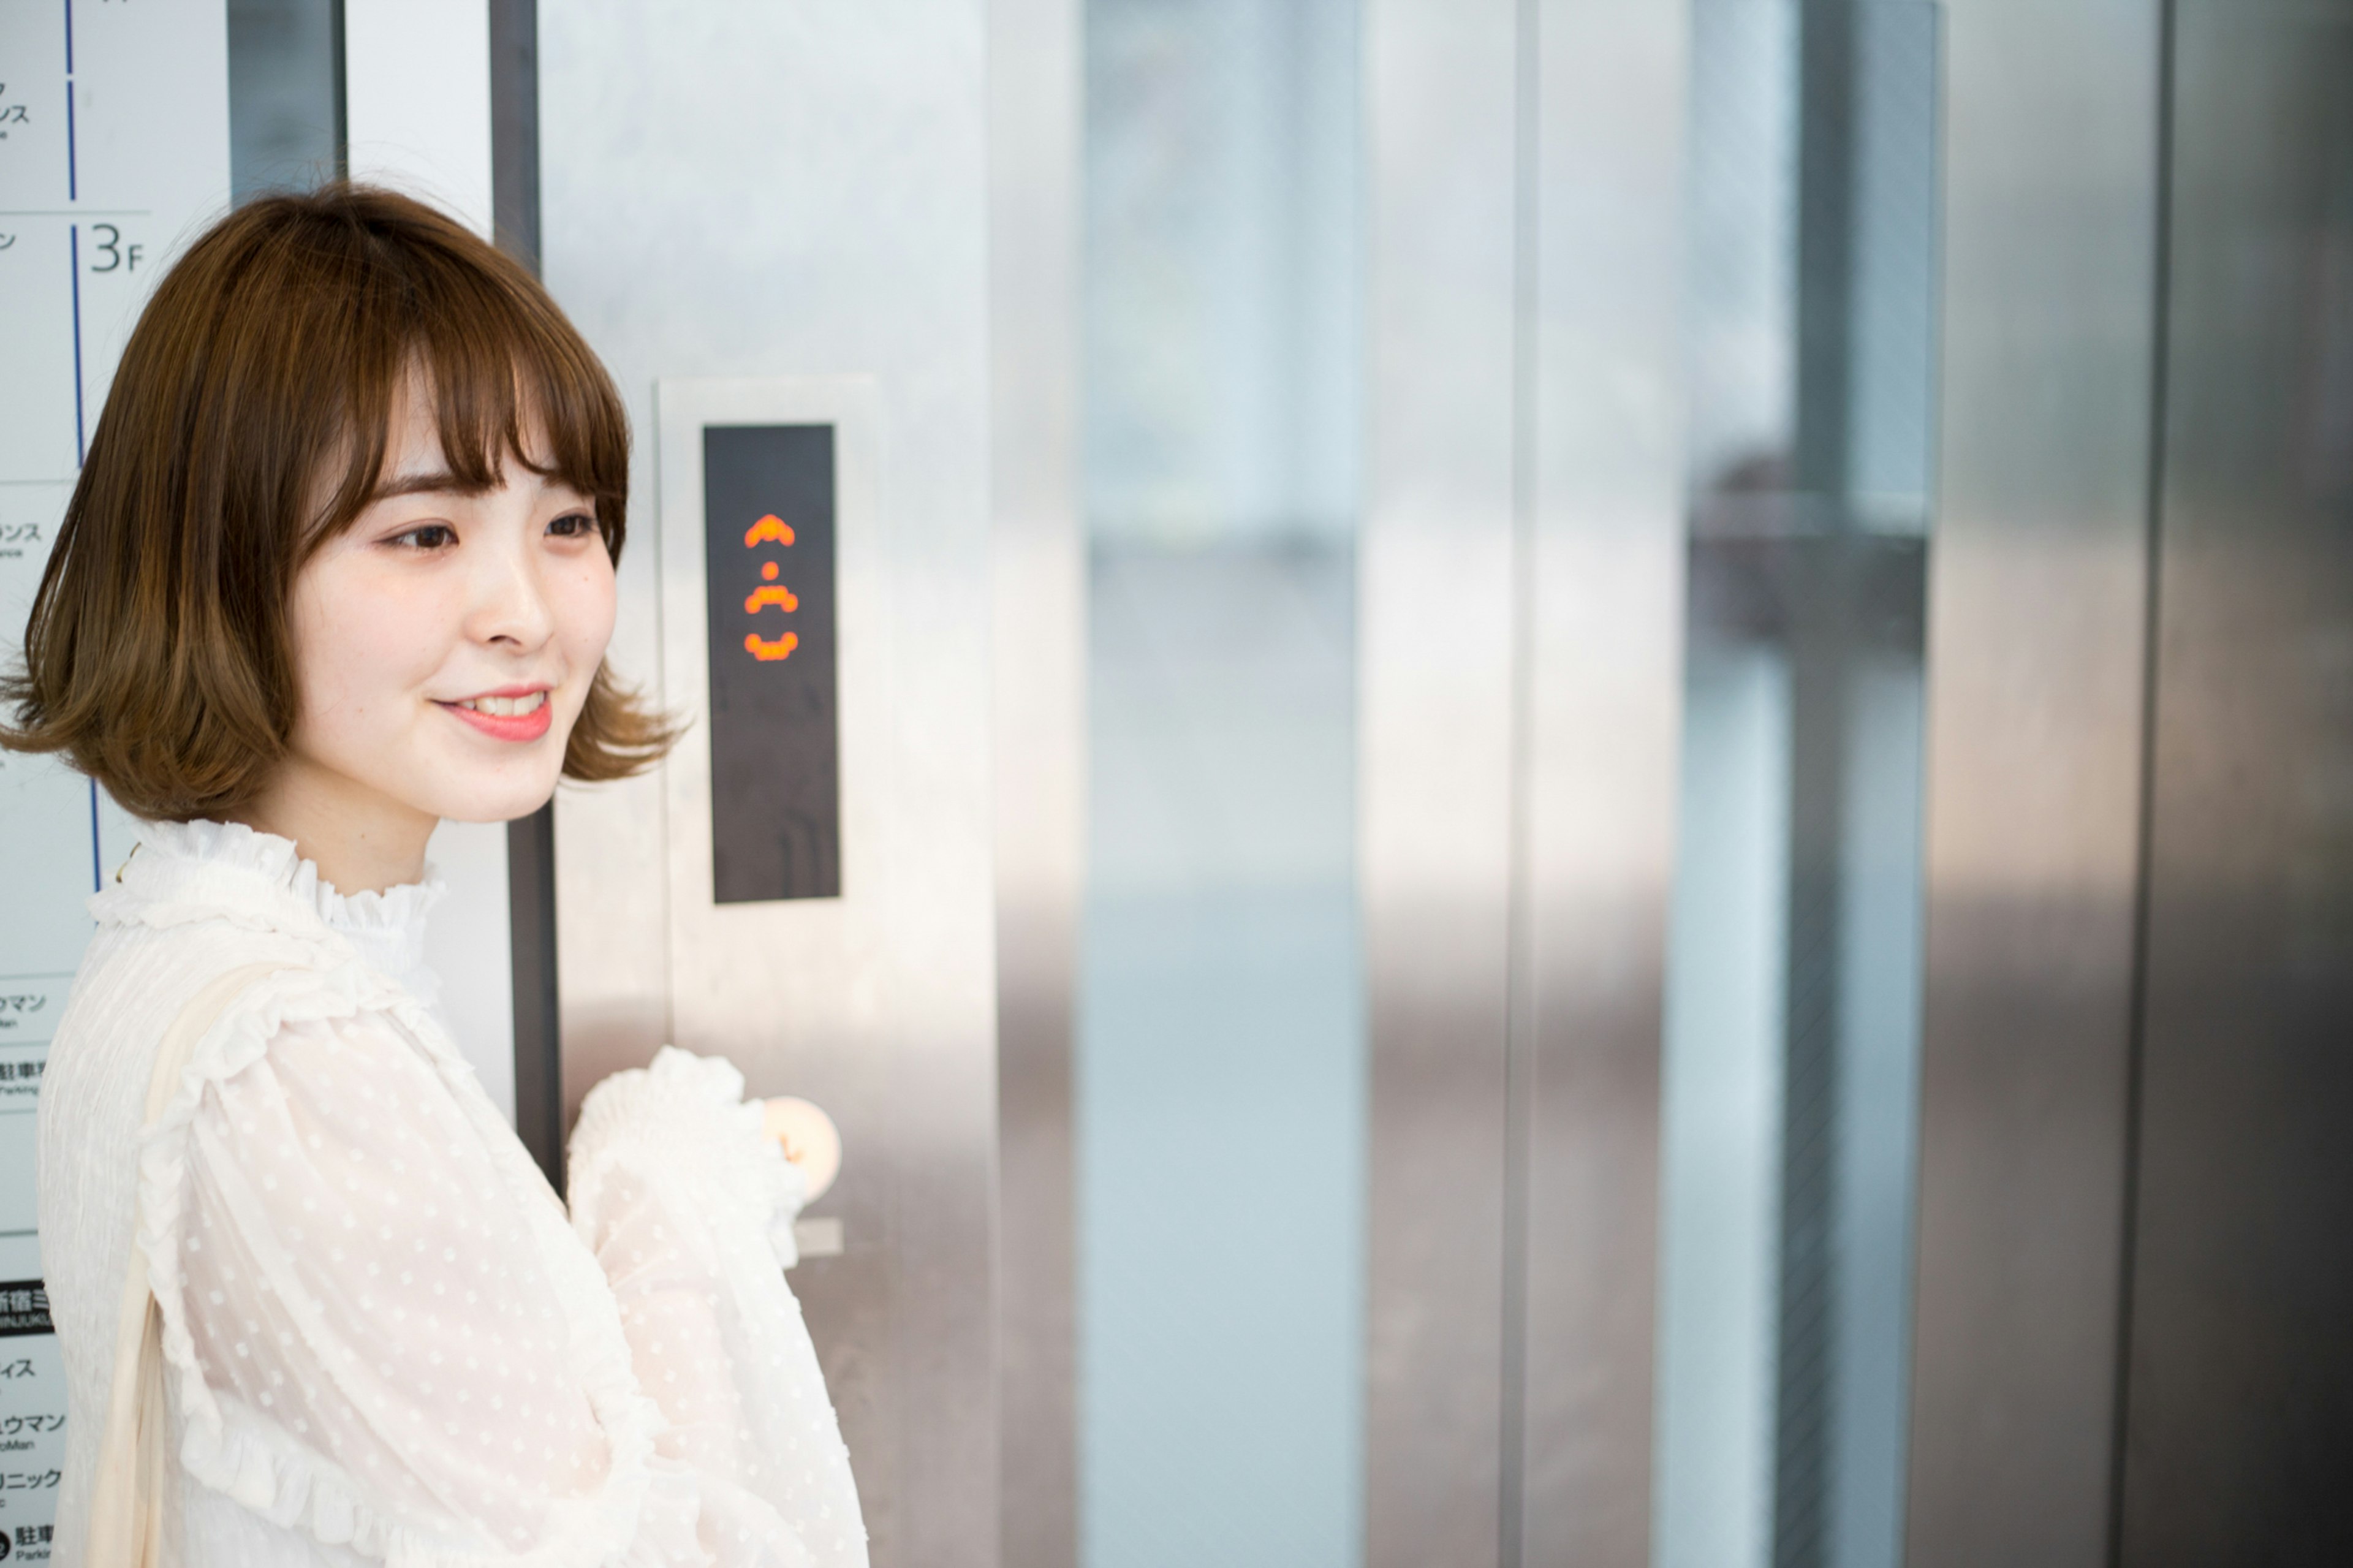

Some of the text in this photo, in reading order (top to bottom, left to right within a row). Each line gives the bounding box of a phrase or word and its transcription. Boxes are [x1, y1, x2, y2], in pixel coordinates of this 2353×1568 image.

[92, 224, 142, 271] 3F
[0, 523, 41, 542] ンス
[0, 1414, 65, 1434] ウマン
